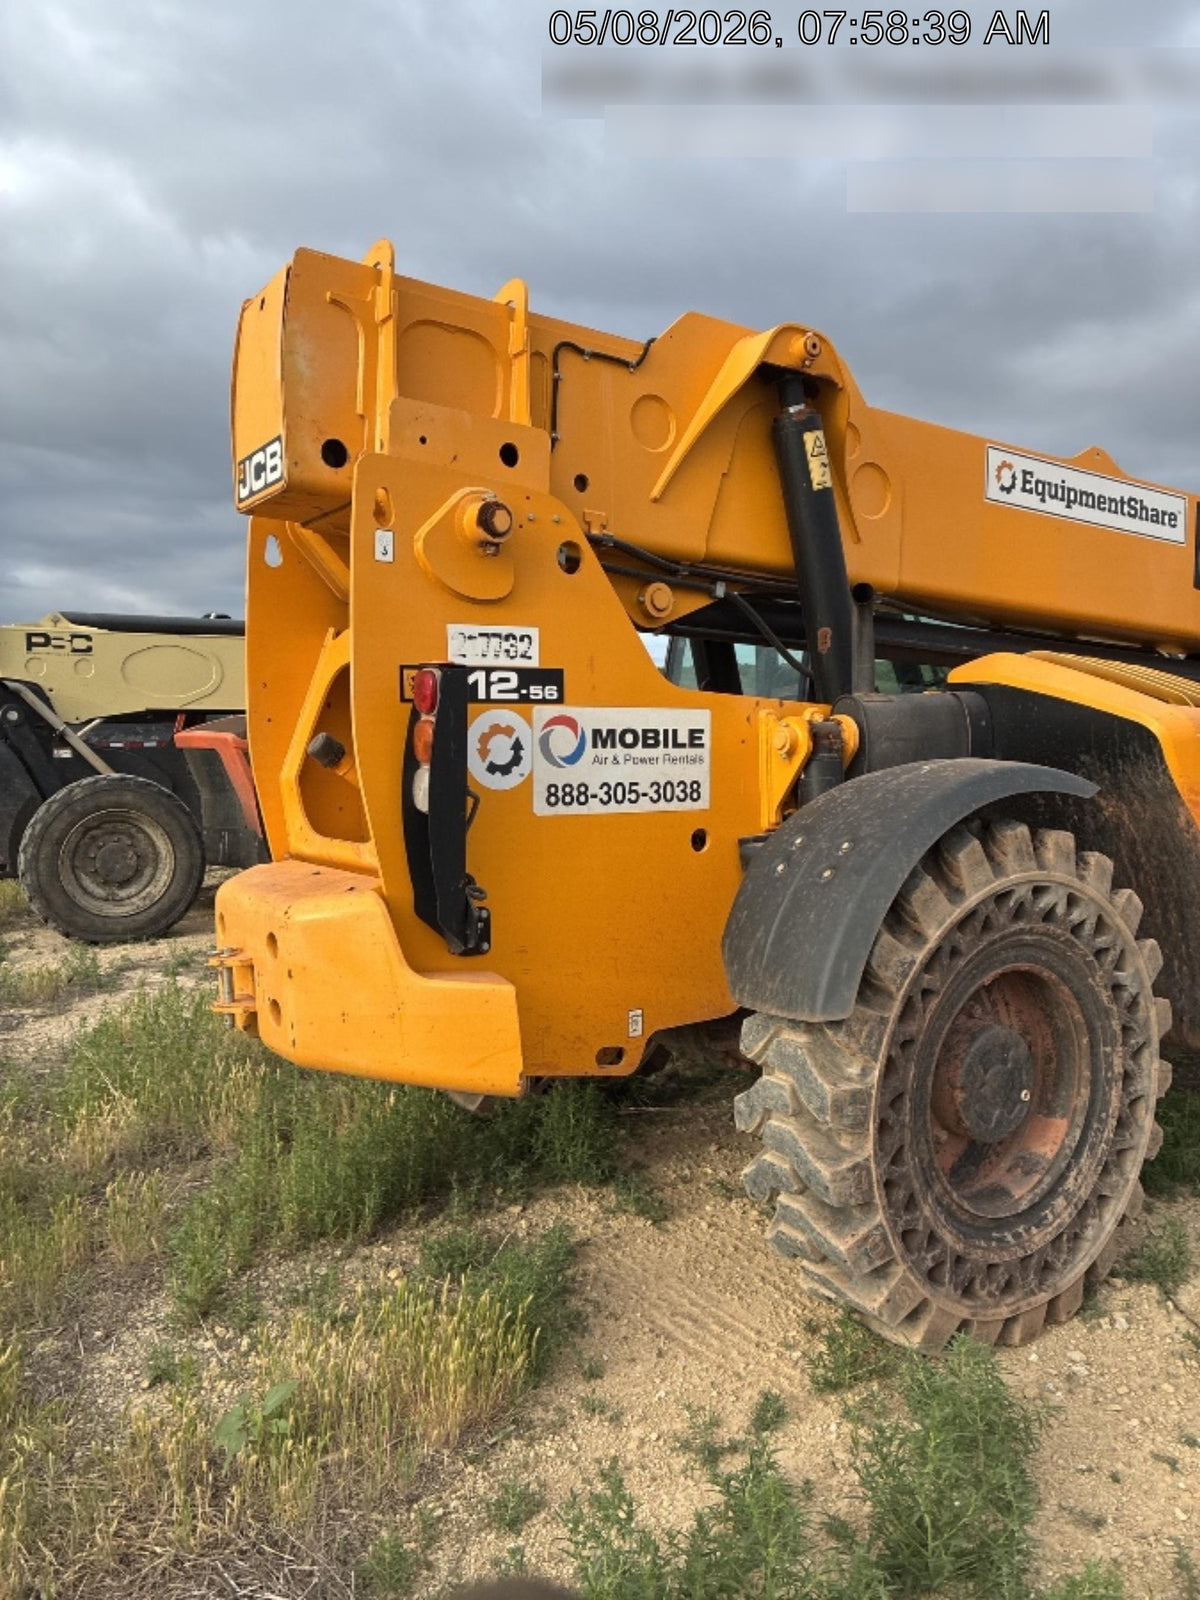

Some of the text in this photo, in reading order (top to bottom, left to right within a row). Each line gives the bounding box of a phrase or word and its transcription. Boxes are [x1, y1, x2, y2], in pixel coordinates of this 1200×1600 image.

[239, 440, 282, 499] JCB
[1021, 469, 1178, 528] EquipmentShare
[467, 669, 559, 700] 12-56
[591, 728, 705, 749] MOBILE
[592, 754, 705, 766] Air & Power Rentals
[546, 780, 701, 807] 888-305-3038
